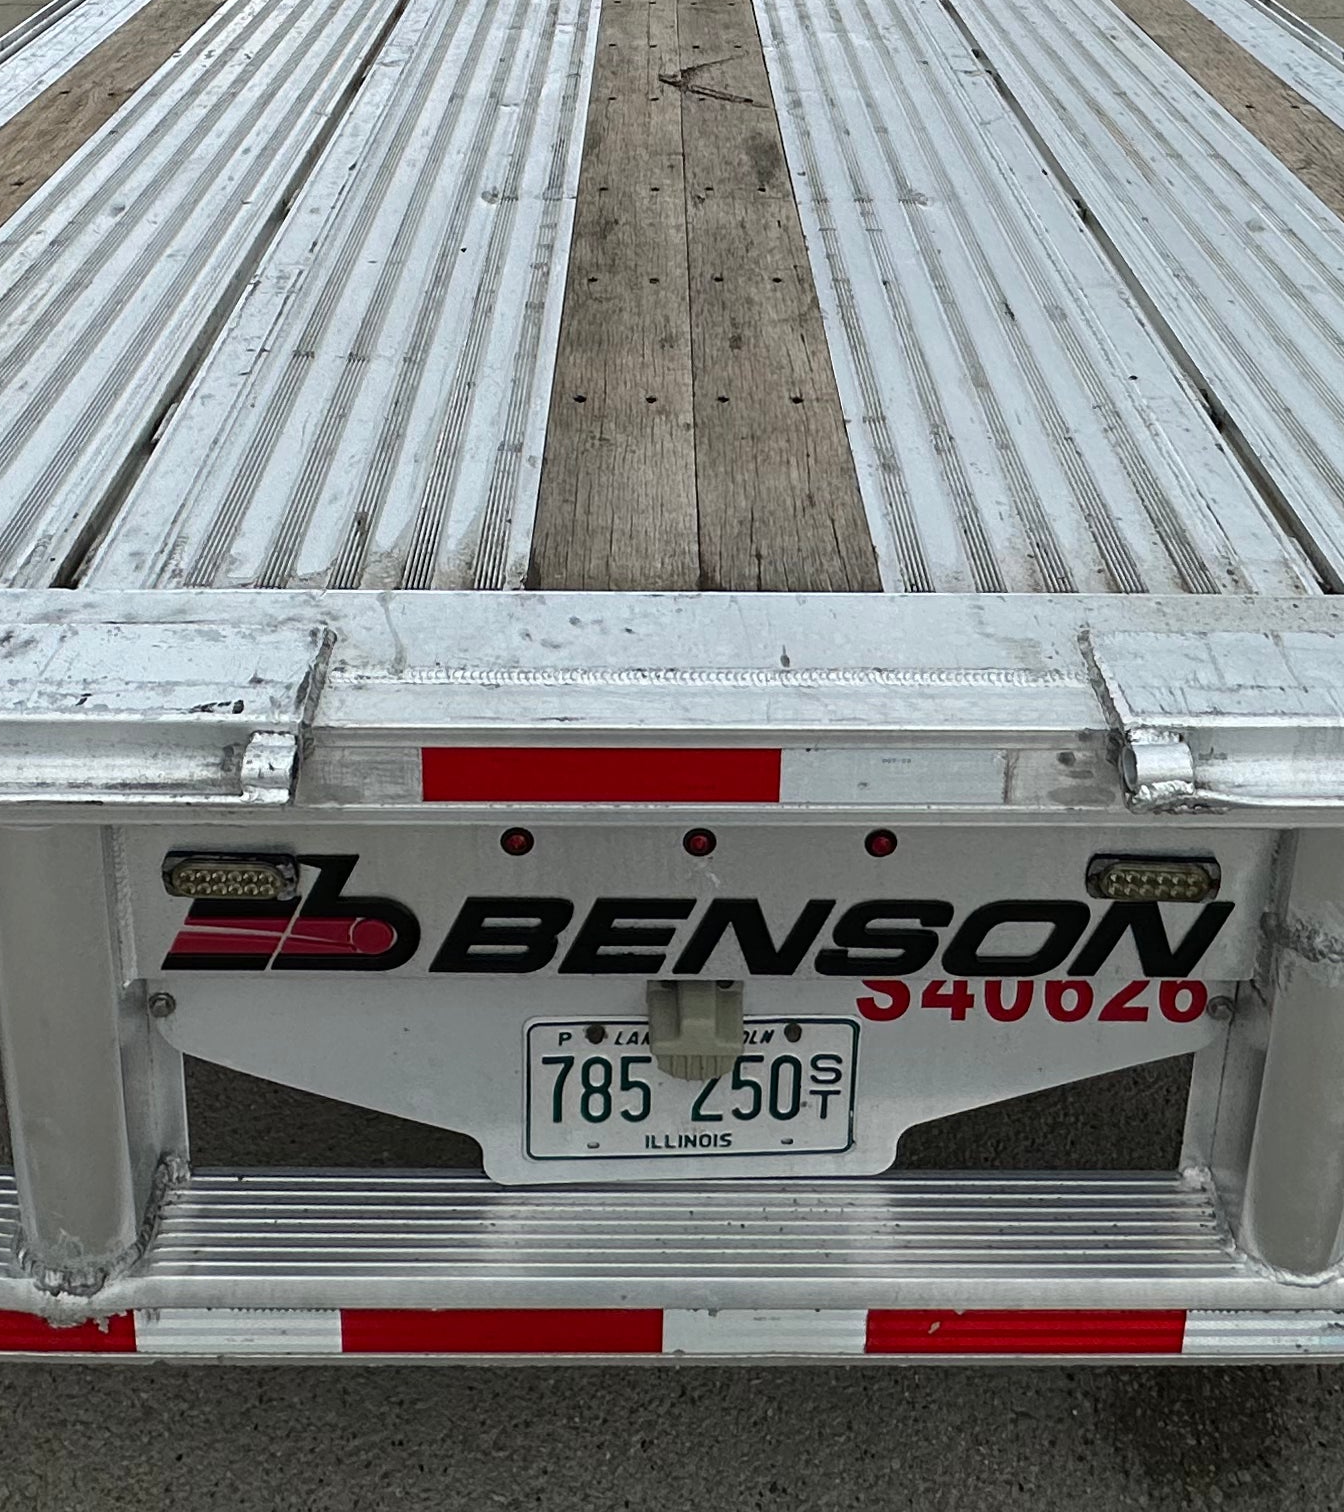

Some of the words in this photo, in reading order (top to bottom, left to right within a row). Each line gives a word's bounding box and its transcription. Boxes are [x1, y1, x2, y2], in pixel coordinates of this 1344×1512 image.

[429, 896, 1236, 978] BENSON
[541, 1055, 653, 1124] 785
[644, 1132, 733, 1150] ILLINOIS
